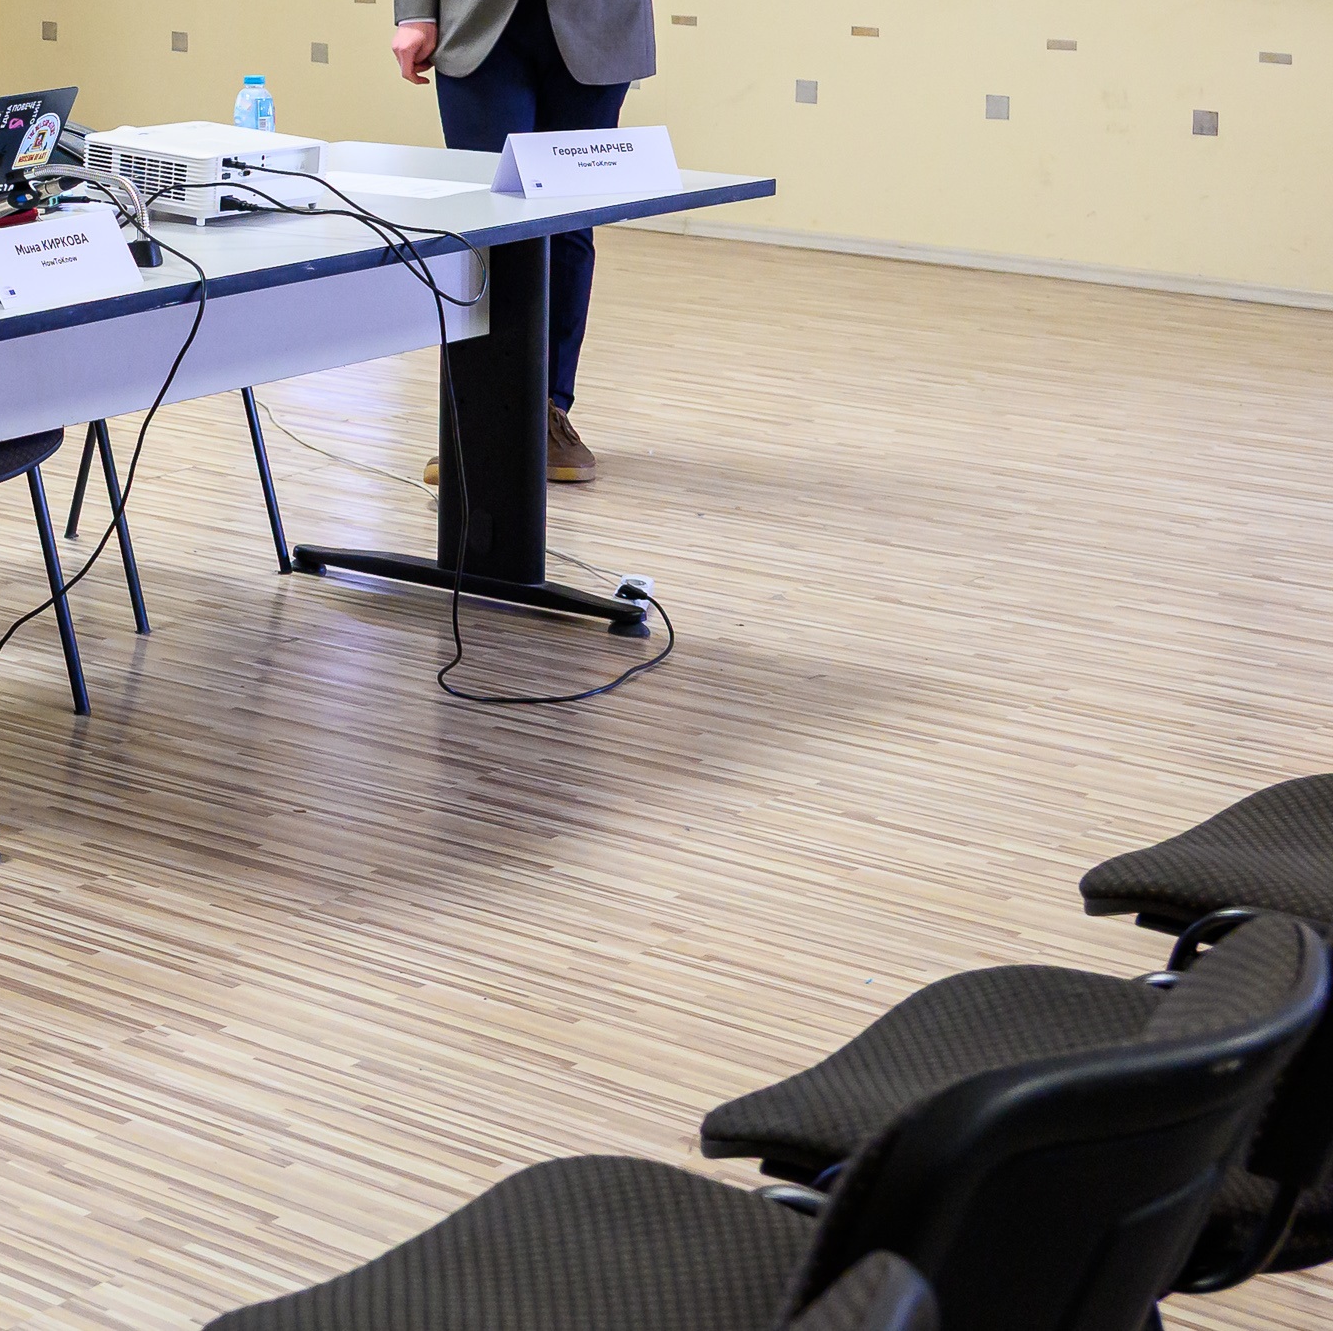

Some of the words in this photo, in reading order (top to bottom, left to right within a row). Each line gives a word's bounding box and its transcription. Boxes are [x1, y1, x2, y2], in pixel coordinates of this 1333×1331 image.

[552, 146, 589, 157] Георги
[590, 142, 634, 154] МАРЧЕВ
[577, 160, 617, 168] HowToKnow
[14, 243, 41, 256] Мина
[41, 232, 89, 251] КИРКОВА
[41, 256, 78, 267] HowToKnow
